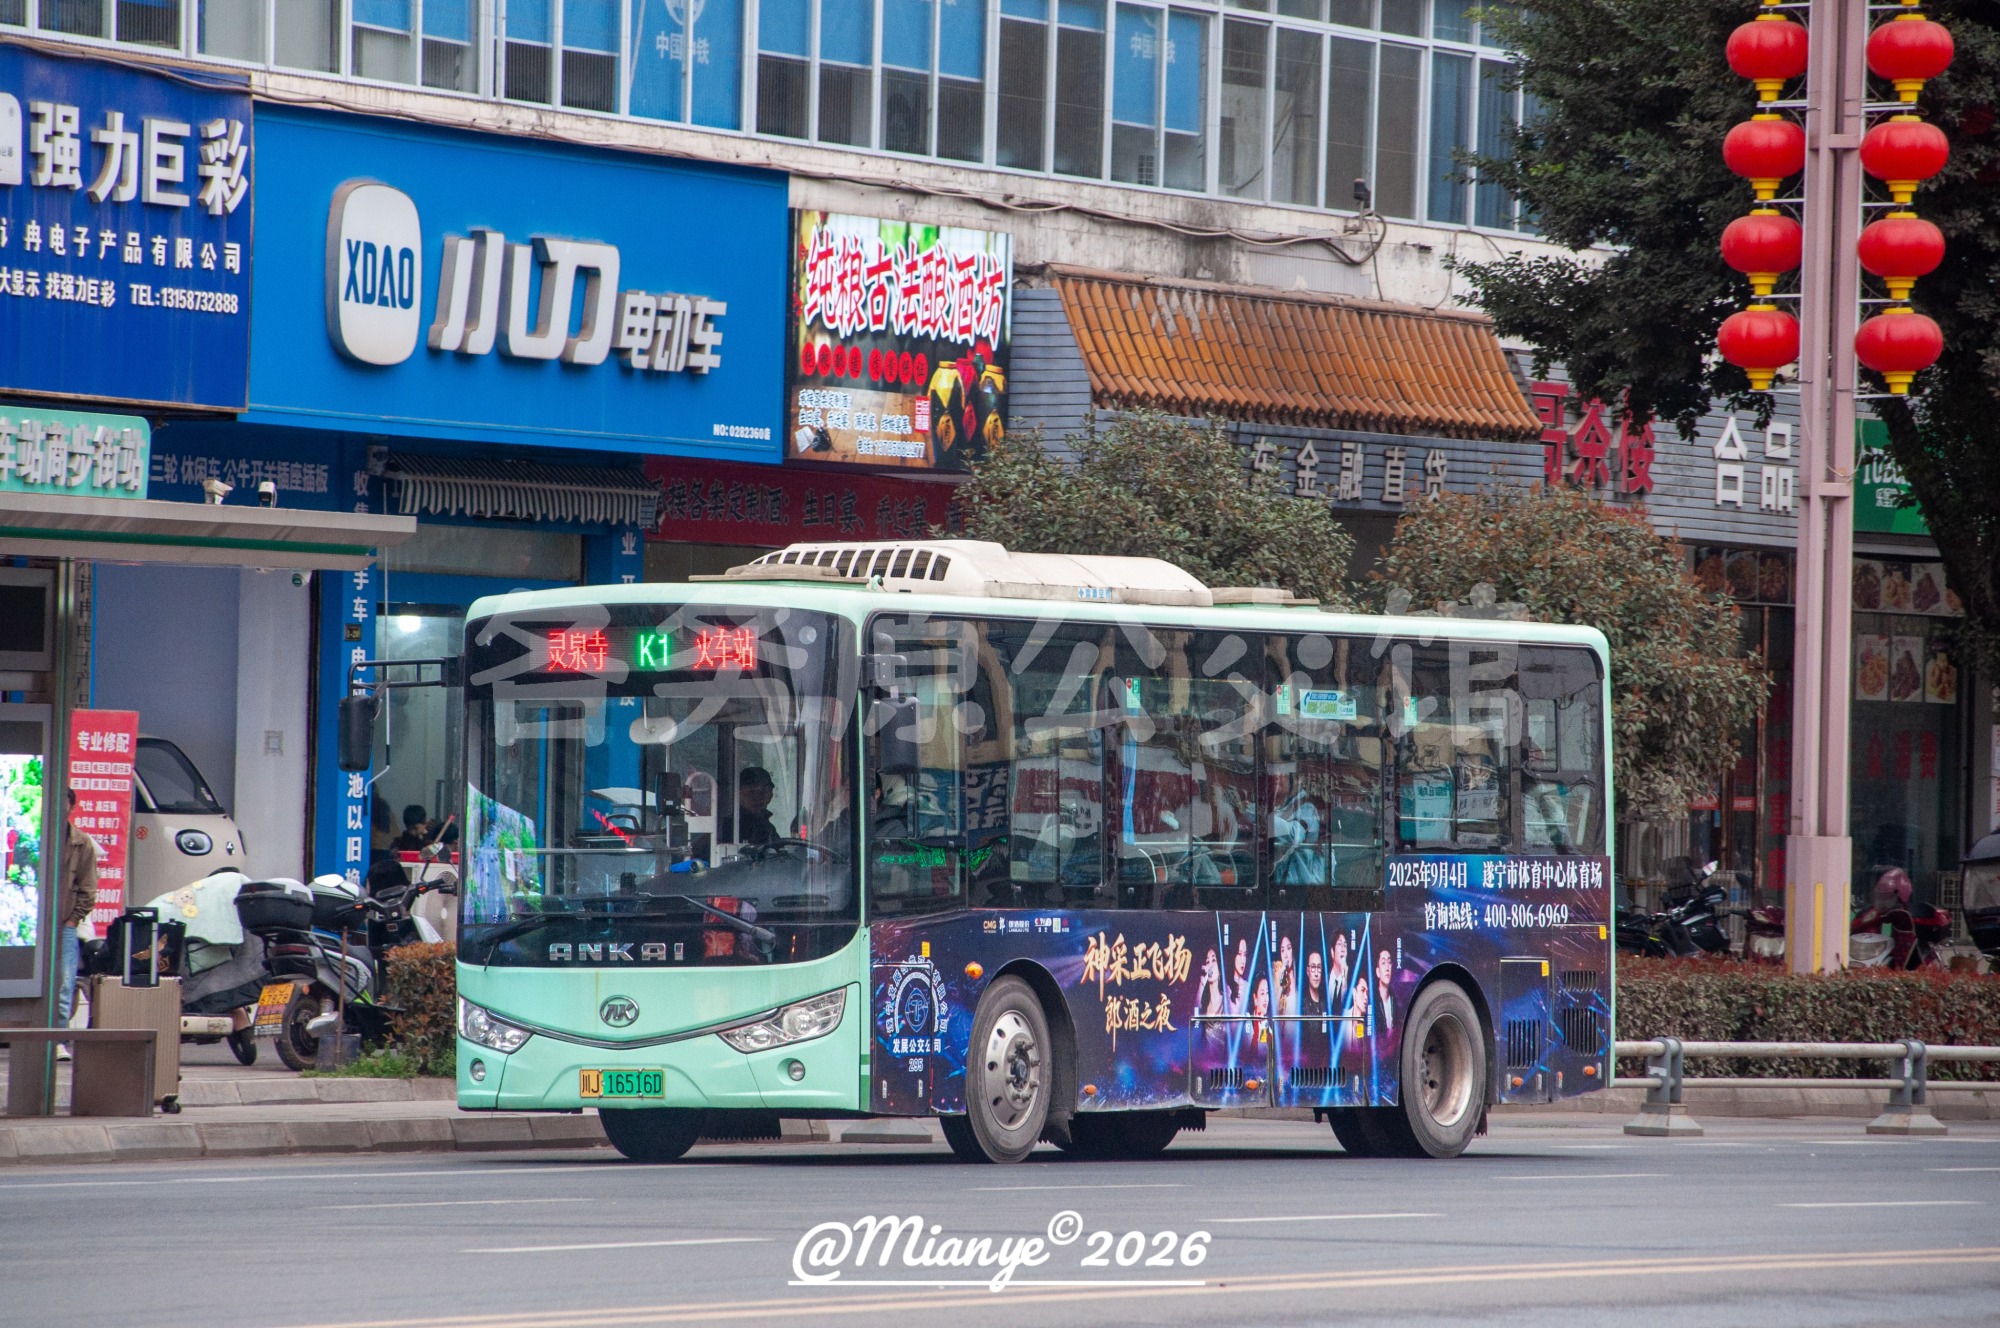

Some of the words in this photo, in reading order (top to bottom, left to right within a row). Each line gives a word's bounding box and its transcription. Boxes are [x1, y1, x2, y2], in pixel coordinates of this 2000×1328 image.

[29, 101, 248, 215] 强力巨彩
[45, 272, 116, 307] 找强力巨彩
[344, 238, 415, 310] XDAO
[804, 224, 1005, 350] 纯粮古法酿酒坊
[151, 454, 178, 483] 三轮
[549, 630, 608, 671] 灵泉寺
[638, 634, 669, 667] K1
[694, 628, 756, 669] 火车站
[77, 731, 130, 753] 专业修配
[1389, 861, 1468, 889] 2025年9月4日
[1482, 860, 1603, 889] 遂宁市体育中心体育场
[549, 942, 684, 961] ANKAI
[1080, 932, 1192, 1001] 神采正飞扬
[1104, 993, 1178, 1053] 郎酒之夜
[893, 1038, 942, 1053] 发展公交公司
